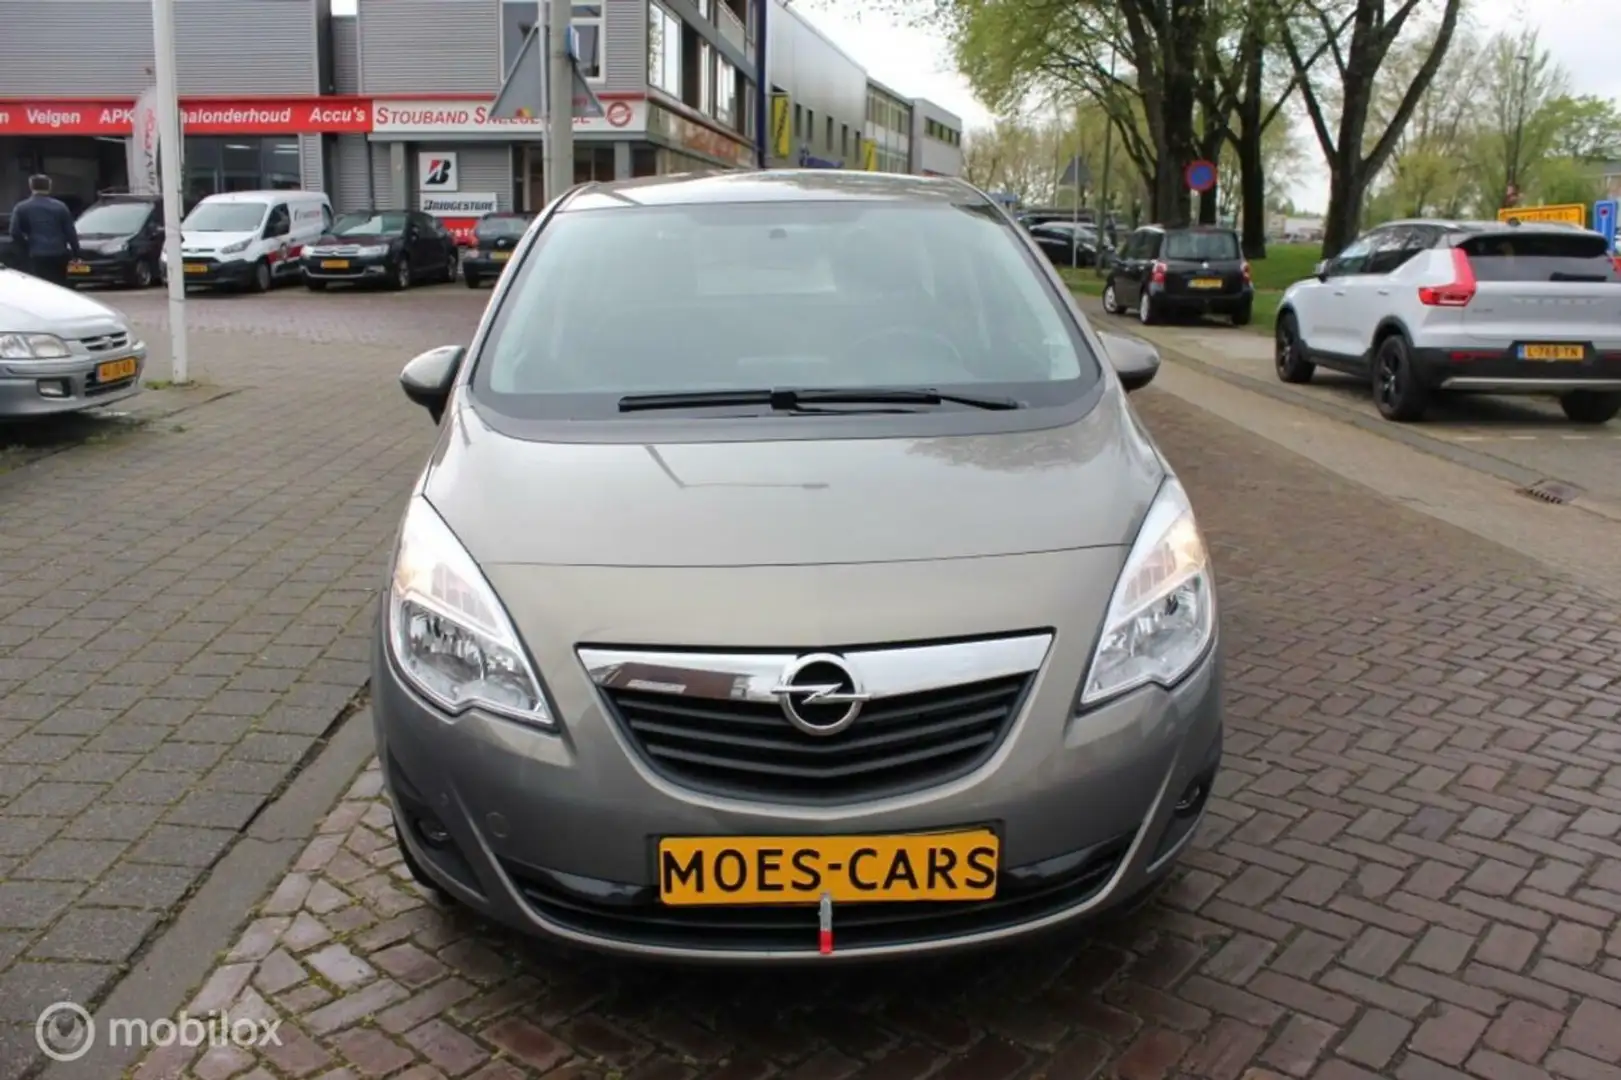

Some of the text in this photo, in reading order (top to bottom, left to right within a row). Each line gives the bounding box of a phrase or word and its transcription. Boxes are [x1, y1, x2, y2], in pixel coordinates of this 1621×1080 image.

[27, 109, 81, 127] Velgen
[309, 107, 366, 122] Accu's
[662, 846, 997, 894] MOES-CARS
